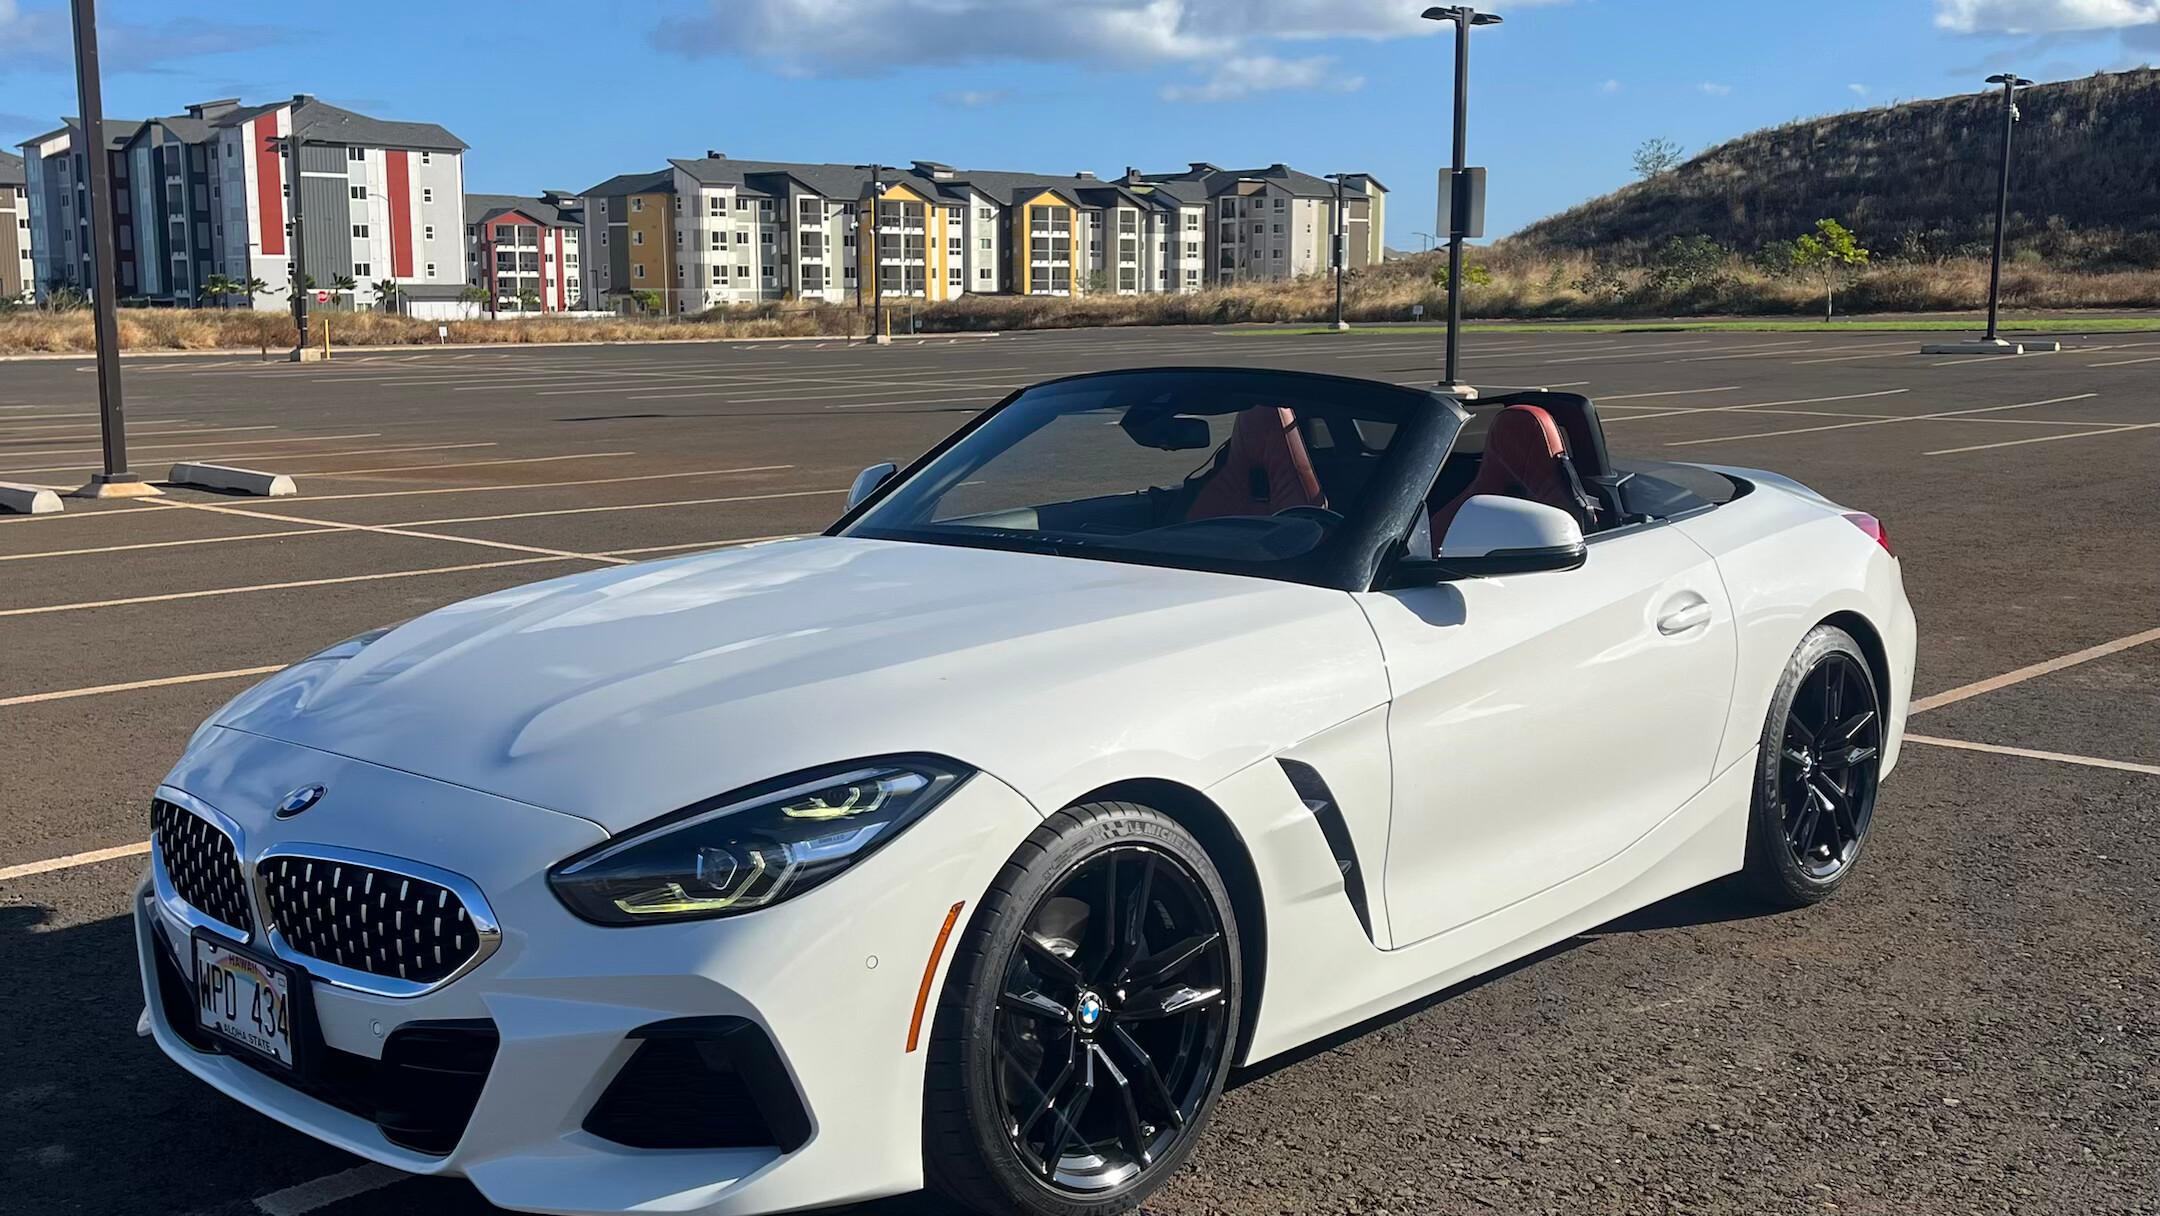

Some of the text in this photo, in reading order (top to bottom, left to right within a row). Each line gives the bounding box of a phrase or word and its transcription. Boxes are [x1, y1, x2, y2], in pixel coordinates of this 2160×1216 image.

[228, 953, 257, 975] HAWAII
[199, 959, 289, 1046] WPD 434
[223, 1023, 271, 1052] ALOHA STATE
